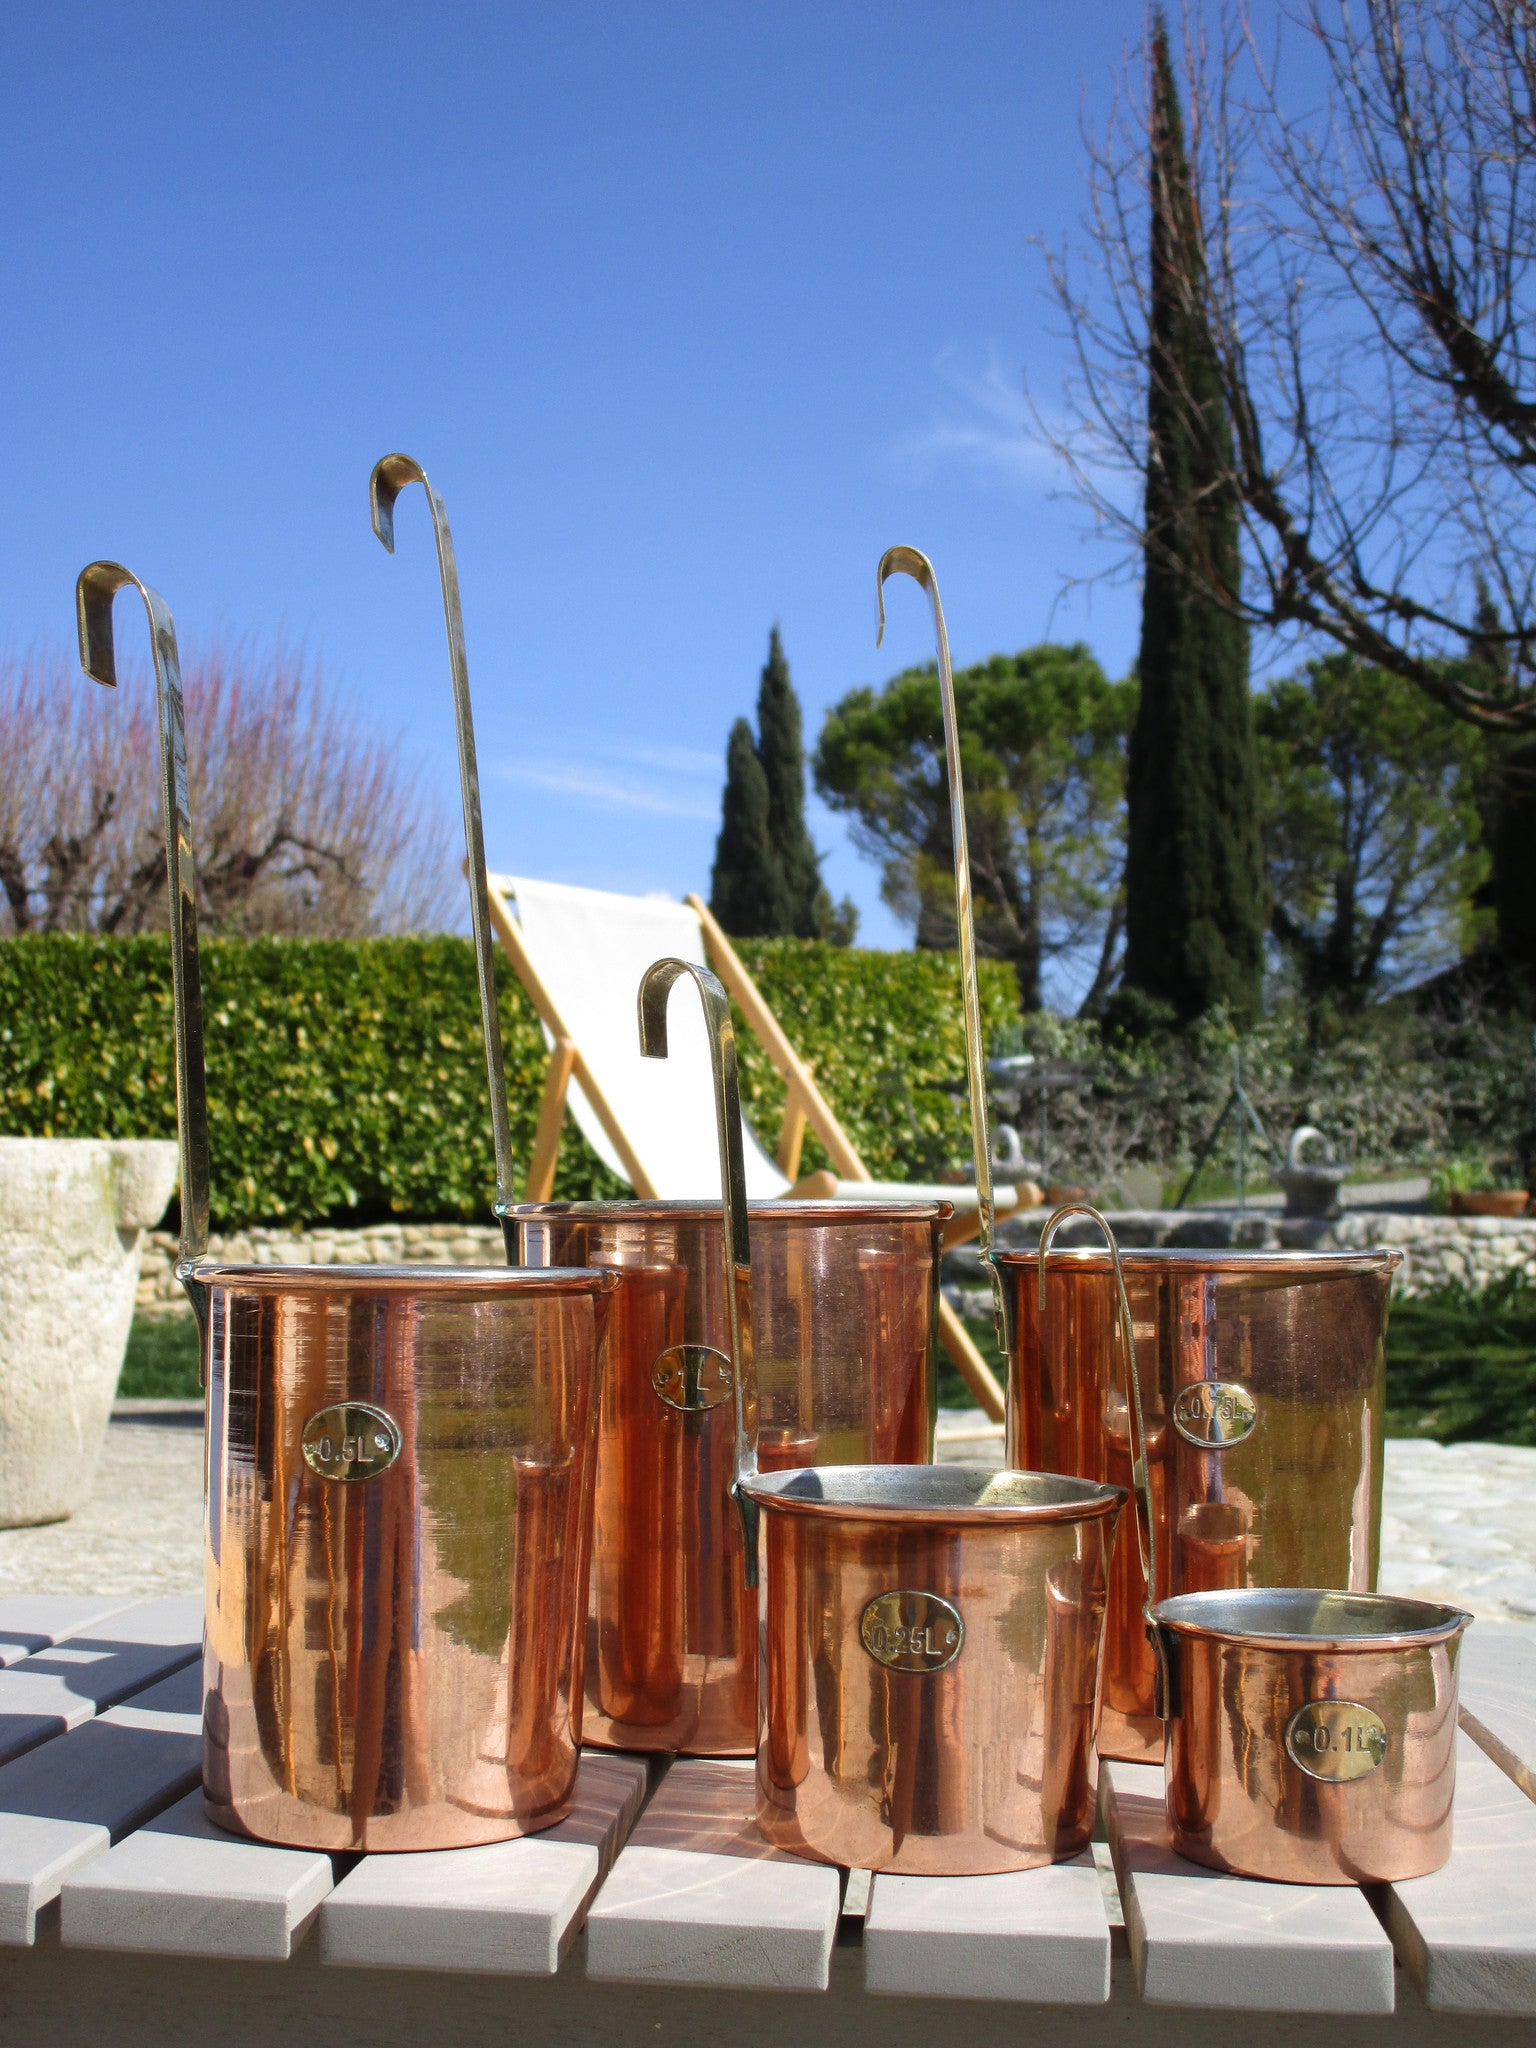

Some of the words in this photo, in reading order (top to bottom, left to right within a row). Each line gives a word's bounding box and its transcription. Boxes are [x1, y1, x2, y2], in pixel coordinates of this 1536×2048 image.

[1191, 1395, 1242, 1419] 0.75L
[319, 1435, 374, 1462] 0.5L
[872, 1625, 943, 1654] 0.25L
[1313, 1725, 1371, 1753] 0.1L
